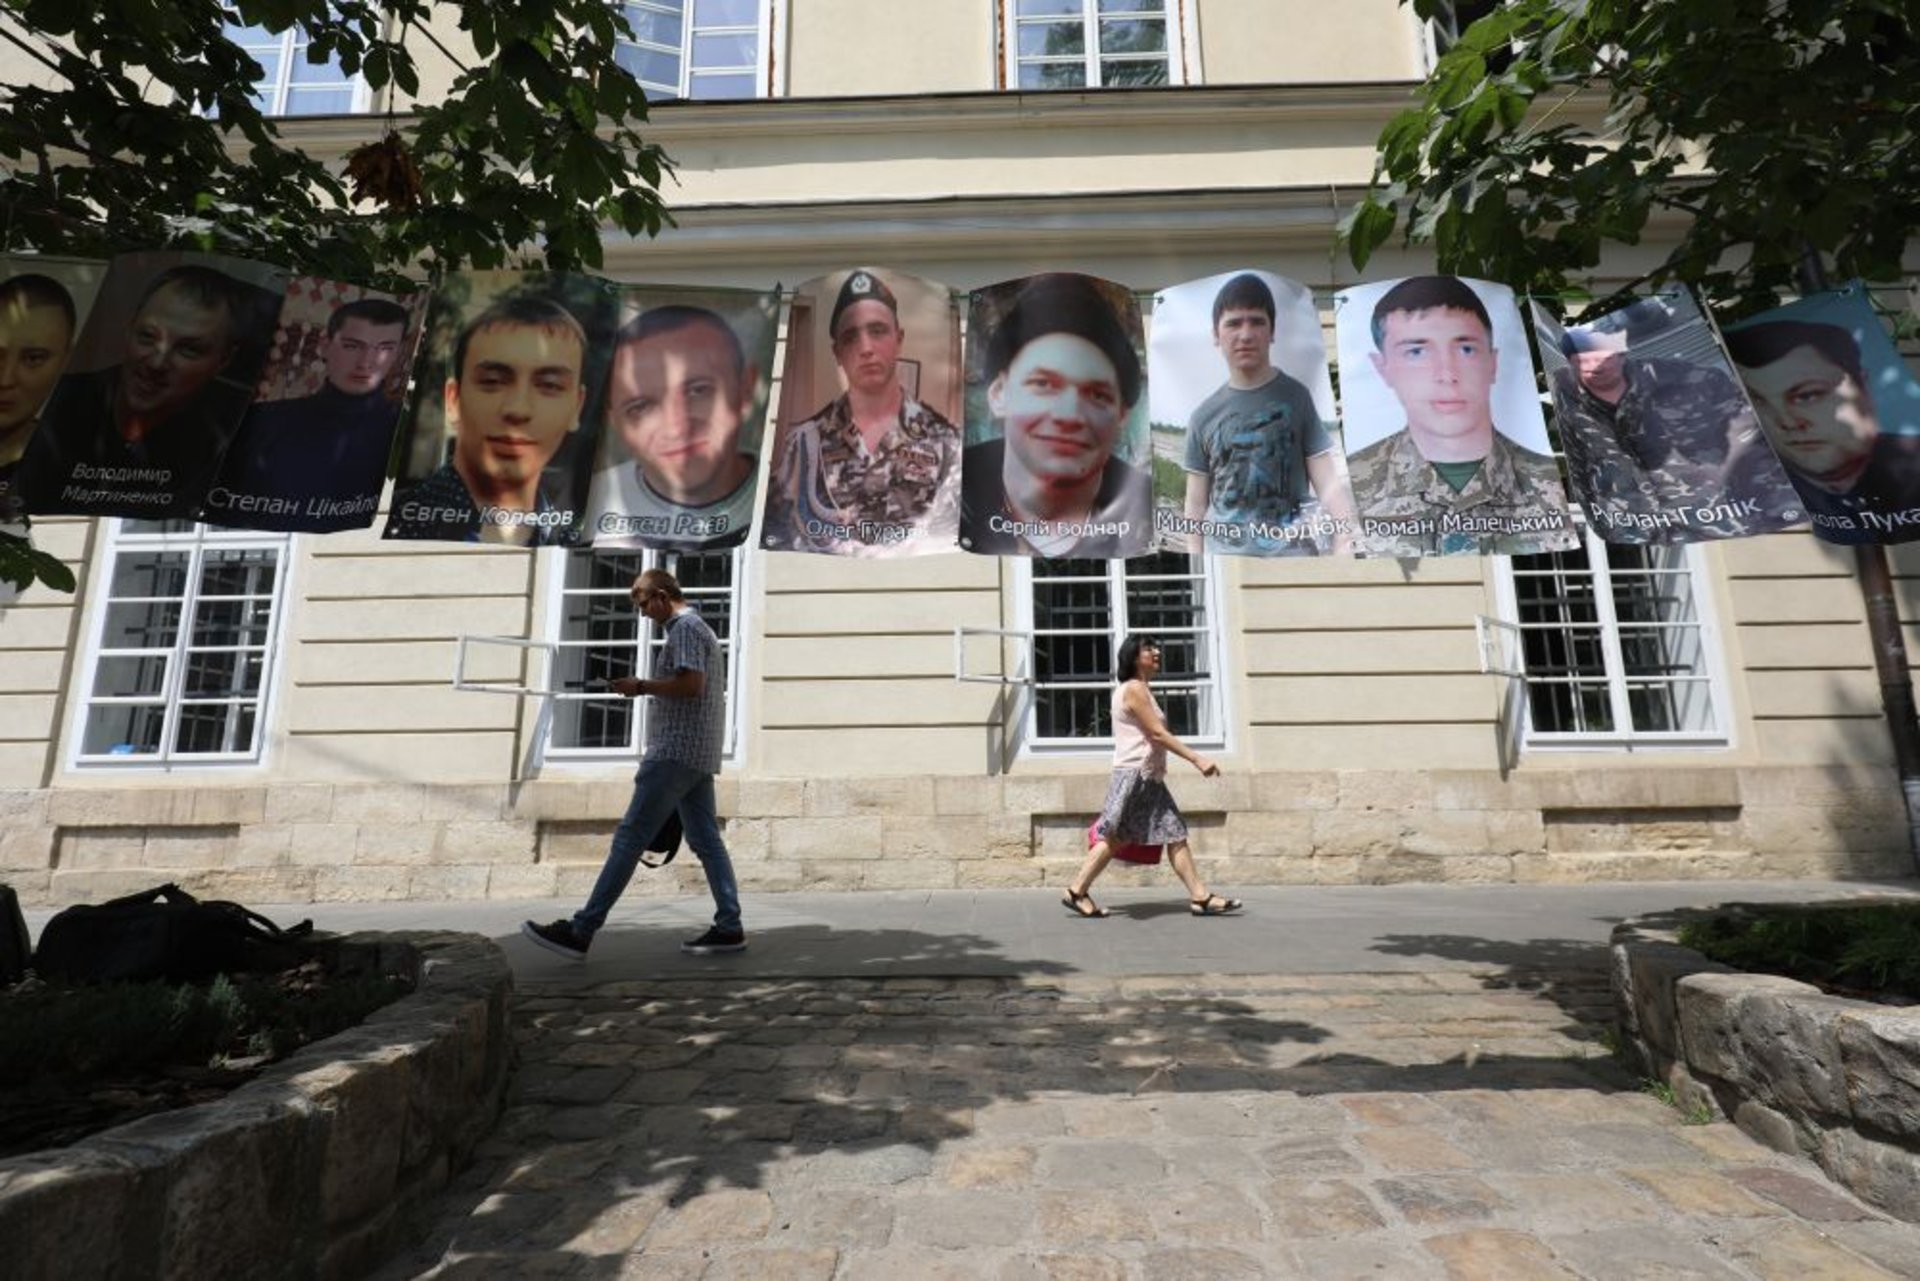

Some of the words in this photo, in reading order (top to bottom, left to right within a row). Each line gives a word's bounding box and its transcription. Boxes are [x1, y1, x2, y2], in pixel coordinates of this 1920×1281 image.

[71, 462, 172, 485] Володимир
[60, 484, 175, 505] Мартиненко
[207, 487, 299, 515] Степан
[401, 502, 471, 524] Євген
[479, 505, 573, 526] Колесов
[600, 512, 669, 534] Євген
[1364, 517, 1435, 537] Роман
[1442, 511, 1563, 535] Малецький
[1590, 502, 1672, 529] Руслан
[1677, 496, 1763, 525] Голік
[806, 520, 854, 539] Олег
[989, 515, 1050, 540] Сергій
[1057, 520, 1130, 539] Боднар
[1155, 510, 1241, 539] Микола
[1249, 516, 1351, 542] Мордюк
